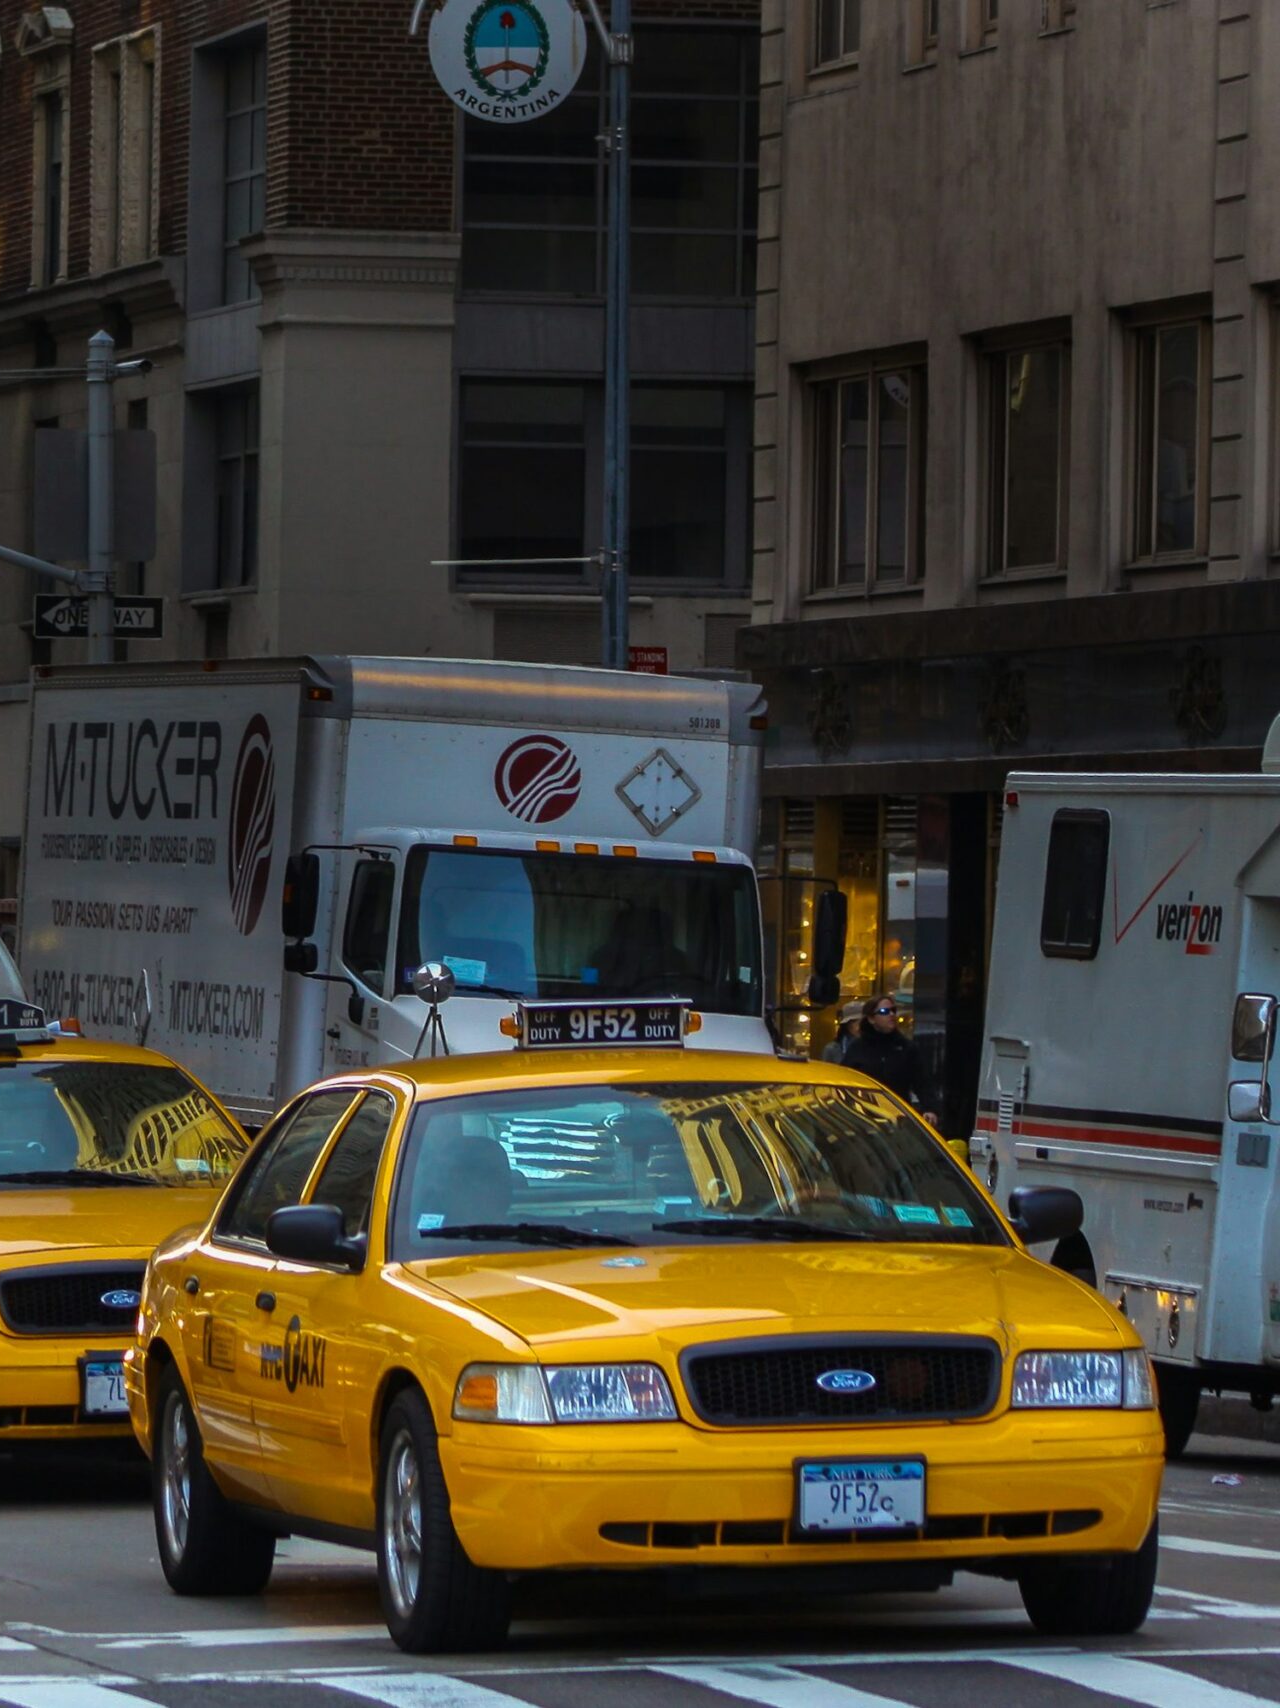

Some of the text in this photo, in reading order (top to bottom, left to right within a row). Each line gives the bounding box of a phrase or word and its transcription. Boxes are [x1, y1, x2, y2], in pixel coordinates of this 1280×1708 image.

[454, 88, 561, 119] ARGENTINA
[55, 609, 89, 625] ONE
[636, 651, 665, 663] STANDING
[115, 835, 142, 862] SUPPLIES
[195, 837, 216, 864] DESIGN
[75, 901, 116, 929] PASSION
[118, 903, 144, 931] SETS
[145, 905, 160, 932] US
[1156, 890, 1223, 955] verizon
[534, 1011, 556, 1024] OFF
[649, 1008, 671, 1020] OFF
[20, 1018, 39, 1027] DUTY
[570, 1008, 637, 1040] 9F52
[530, 1027, 561, 1041] DUTY
[644, 1025, 676, 1038] DUTY
[111, 1292, 135, 1304] Ford
[831, 1374, 861, 1388] Ford
